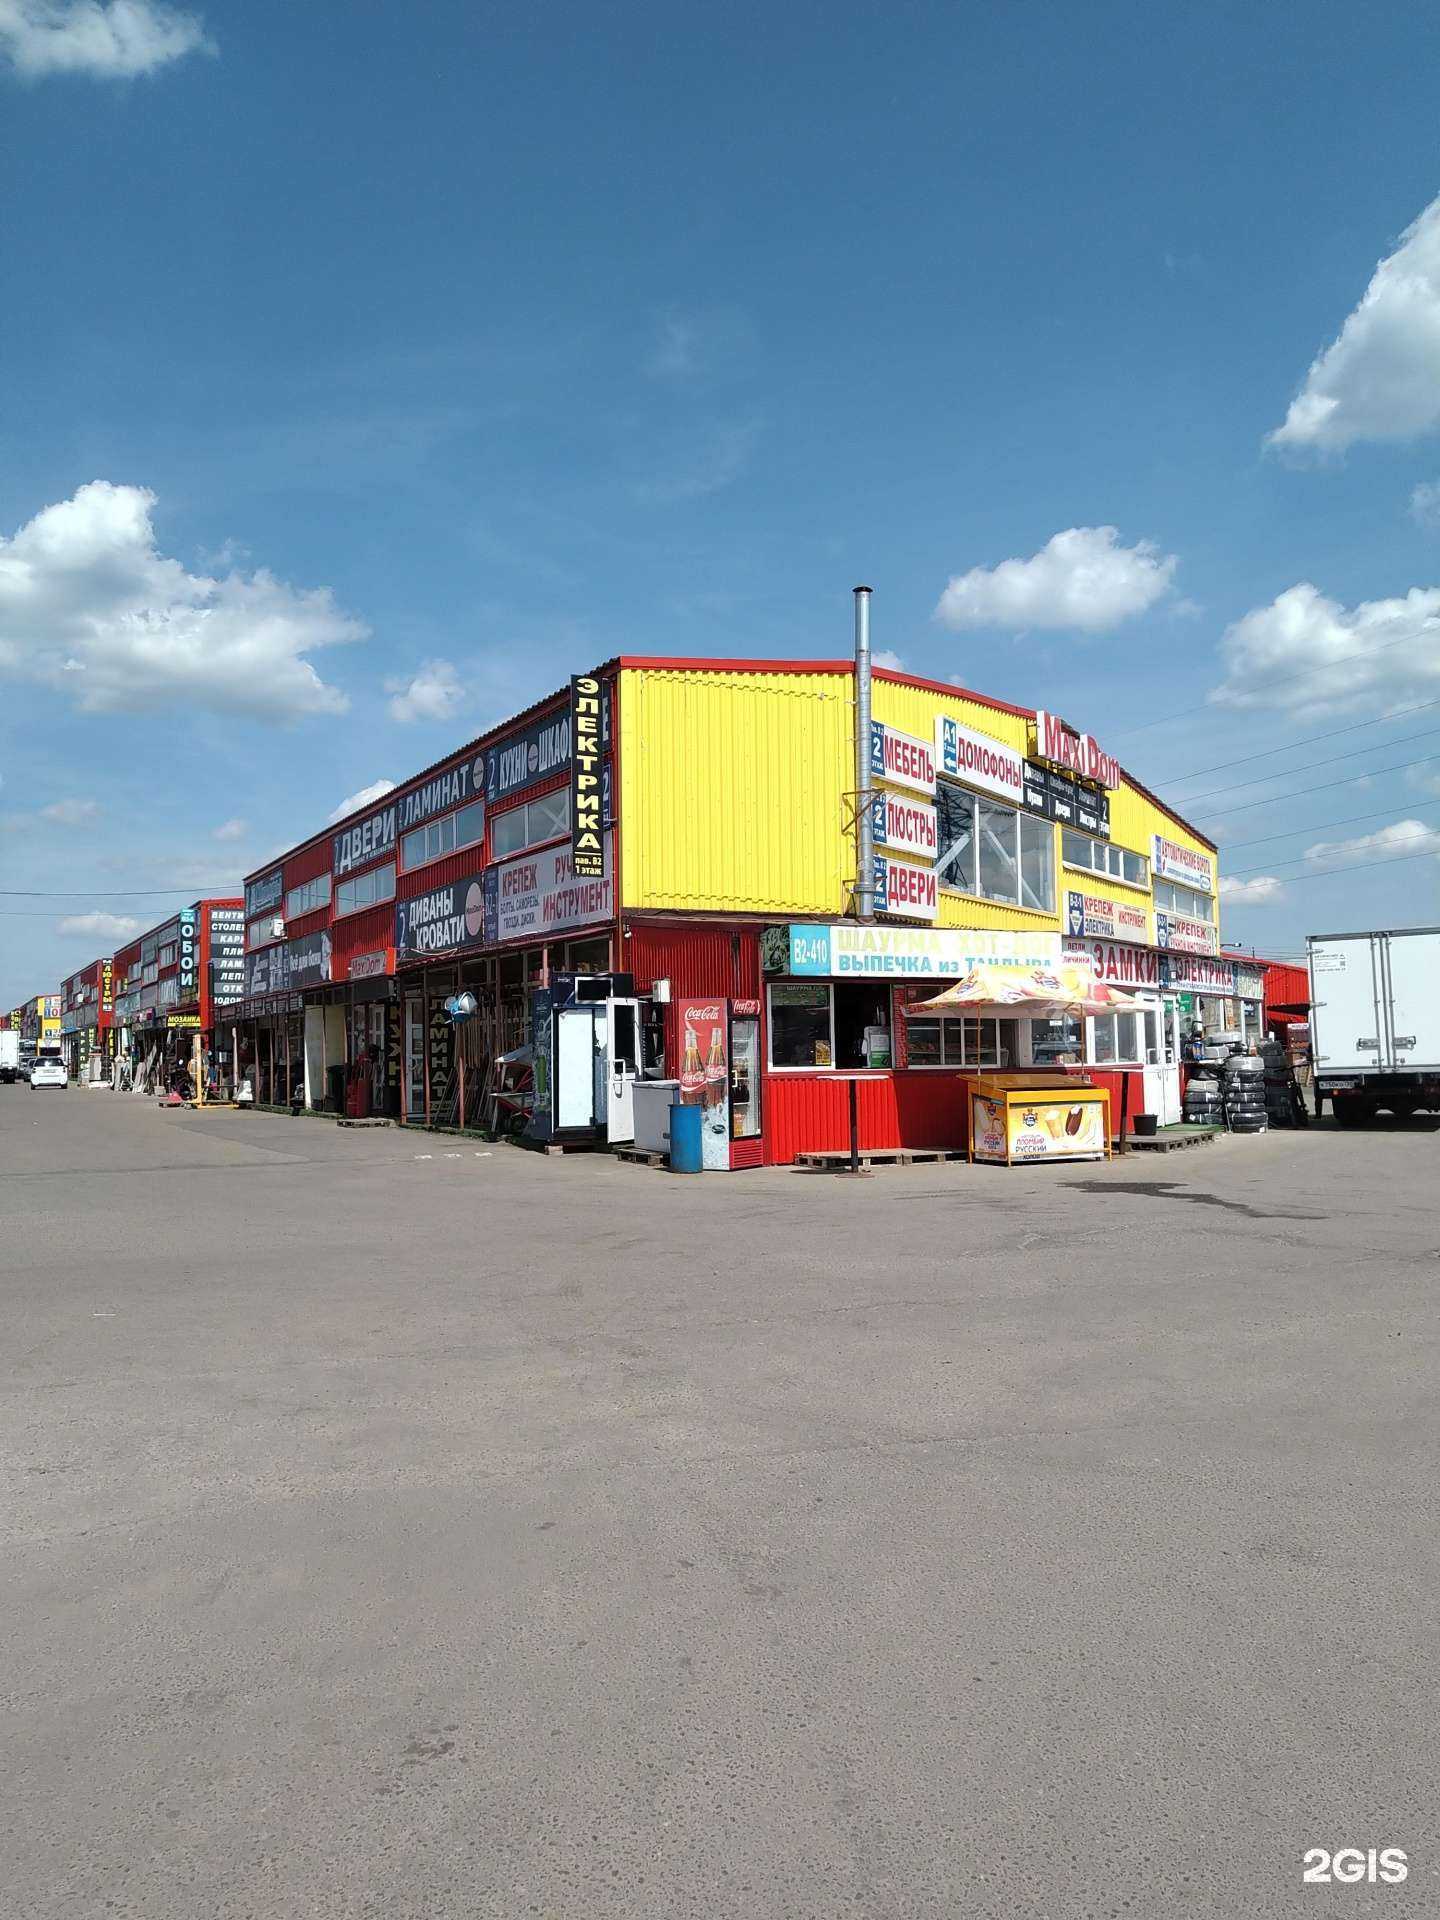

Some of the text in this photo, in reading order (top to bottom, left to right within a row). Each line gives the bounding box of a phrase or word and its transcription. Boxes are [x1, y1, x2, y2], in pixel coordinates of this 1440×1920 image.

[576, 678, 601, 849] ЭЛЕКТРИКА
[873, 737, 881, 757] 2
[885, 735, 934, 783] МЕБЕЛЬ
[958, 737, 1021, 789] ДОМОФОНЫ
[500, 741, 527, 790] КУХНИ
[405, 764, 469, 826] ЛАМИНАТ
[874, 805, 883, 825] 2
[887, 802, 936, 848] ЛЮСТРЫ
[340, 808, 395, 874] ДВЕРИ
[575, 857, 591, 865] пав.
[581, 867, 602, 875] этаж
[502, 864, 538, 897] КРЕПЕЖ
[888, 866, 936, 907] ДВЕРИ
[409, 888, 453, 932] ДИВАНЫ
[543, 880, 610, 922] ИНСТРУМЕНТ
[1084, 897, 1114, 917] КРЕПЕЖ
[399, 911, 406, 947] 2
[416, 914, 465, 949] КРОВАТИ
[838, 930, 941, 954] ШАУРМА
[1085, 918, 1114, 936] ЭЛЕКТРИКА
[1176, 920, 1206, 939] КРЕПЕЖ
[181, 925, 194, 986] ОБОИ
[838, 955, 932, 972] ВЫПЕЧКА
[939, 960, 959, 973] из
[1063, 956, 1090, 964] ЛИЧИНКИ
[1067, 943, 1086, 951] ПЕТЛИ
[1094, 943, 1157, 984] ЗАМКИ
[1175, 957, 1232, 986] ЭЛЕКТРИКА
[430, 999, 448, 1097] ЛАМИНАТ
